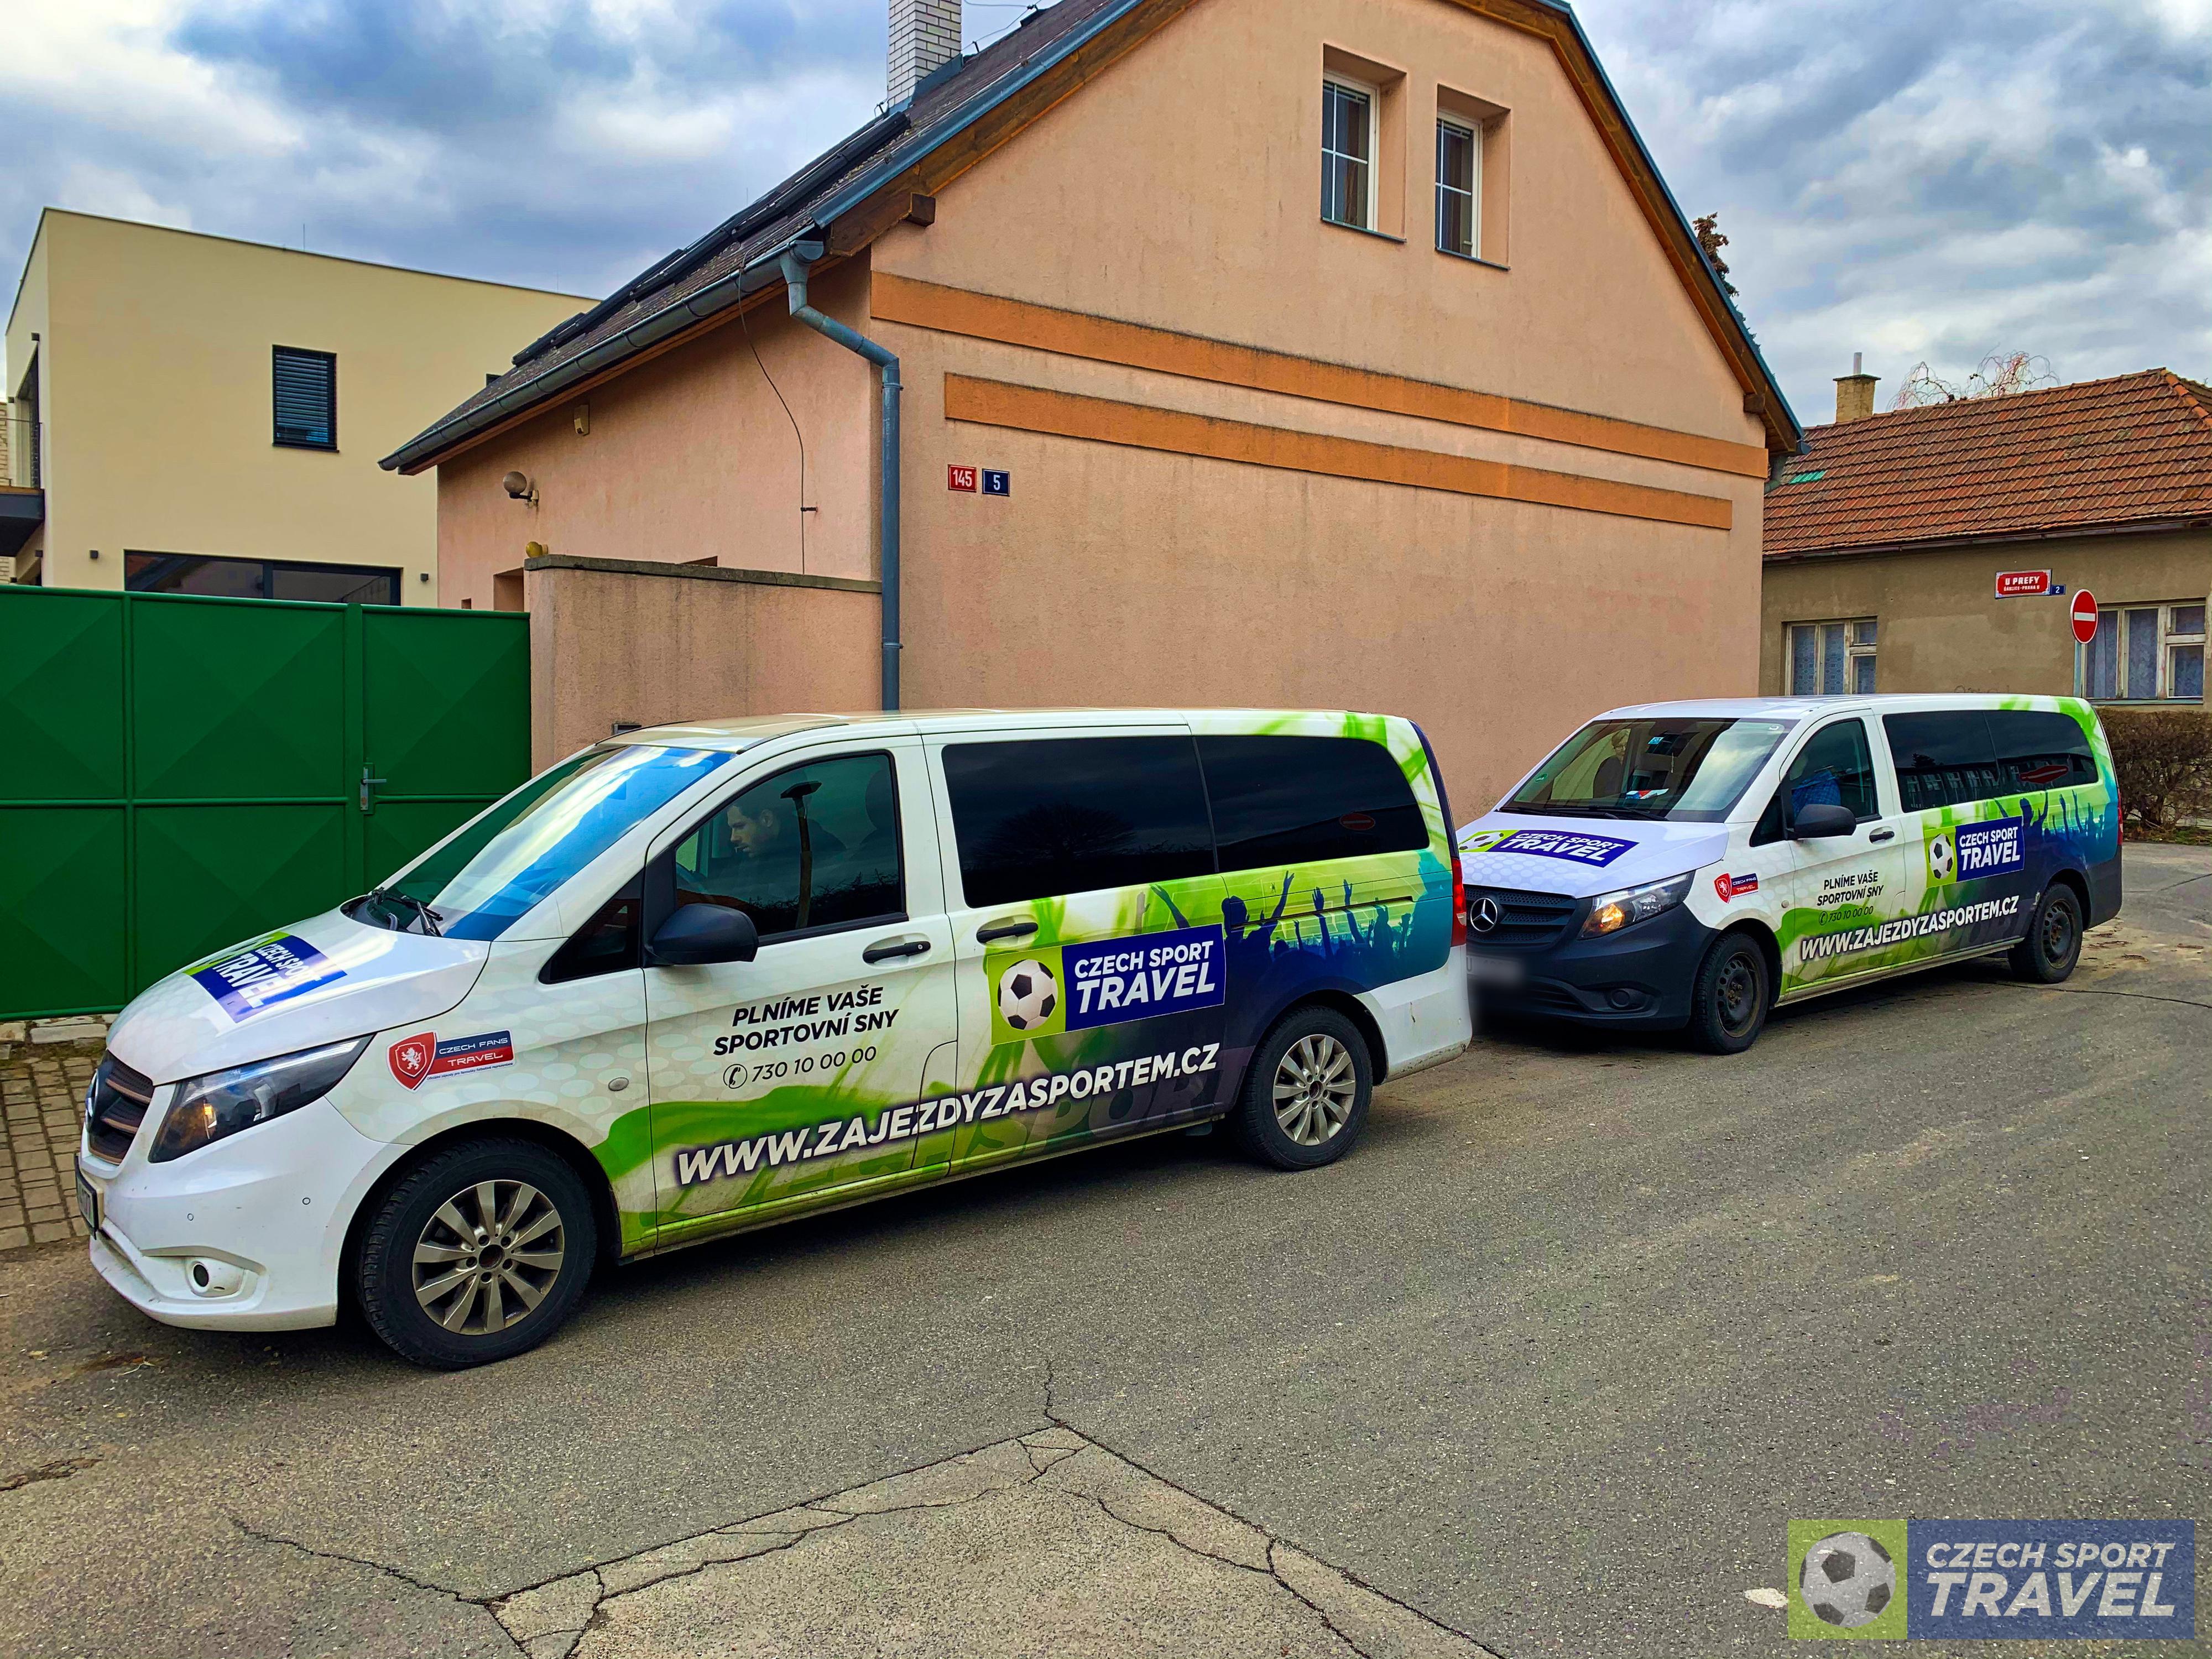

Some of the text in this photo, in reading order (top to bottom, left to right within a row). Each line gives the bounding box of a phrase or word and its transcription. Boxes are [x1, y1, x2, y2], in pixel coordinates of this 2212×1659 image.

[953, 469, 972, 487] 145
[993, 474, 1000, 491] 5
[2012, 576, 2040, 585] PREFY
[1515, 833, 1625, 849] CZECH SPORT
[1959, 827, 2018, 848] CZECH SPORT
[1500, 838, 1611, 862] TRAVEL
[1960, 840, 2020, 871] TRAVEL
[1824, 870, 1879, 890] PLNÍME VAŠE
[1817, 885, 1884, 906] SPORTOVNÍ SNY
[1828, 906, 1874, 922] 730 10 00 00
[1802, 895, 2020, 961] WWW.ZAJEZDYZASPORTEM.CZ
[255, 943, 295, 963] CZECH
[1074, 941, 1214, 978] CZECH SPORT
[1076, 962, 1215, 1014] TRAVEL
[732, 984, 884, 1027] PLNÍME VAŠE
[713, 1009, 900, 1056] SPORTOVNÍ SNY
[439, 1037, 508, 1055] CZECH FANS
[447, 1052, 503, 1066] TRAVEL
[752, 1046, 877, 1082] 730 10 00 00
[678, 1043, 1220, 1185] WWW.ZAJEZDYZASPORTEM.CZ
